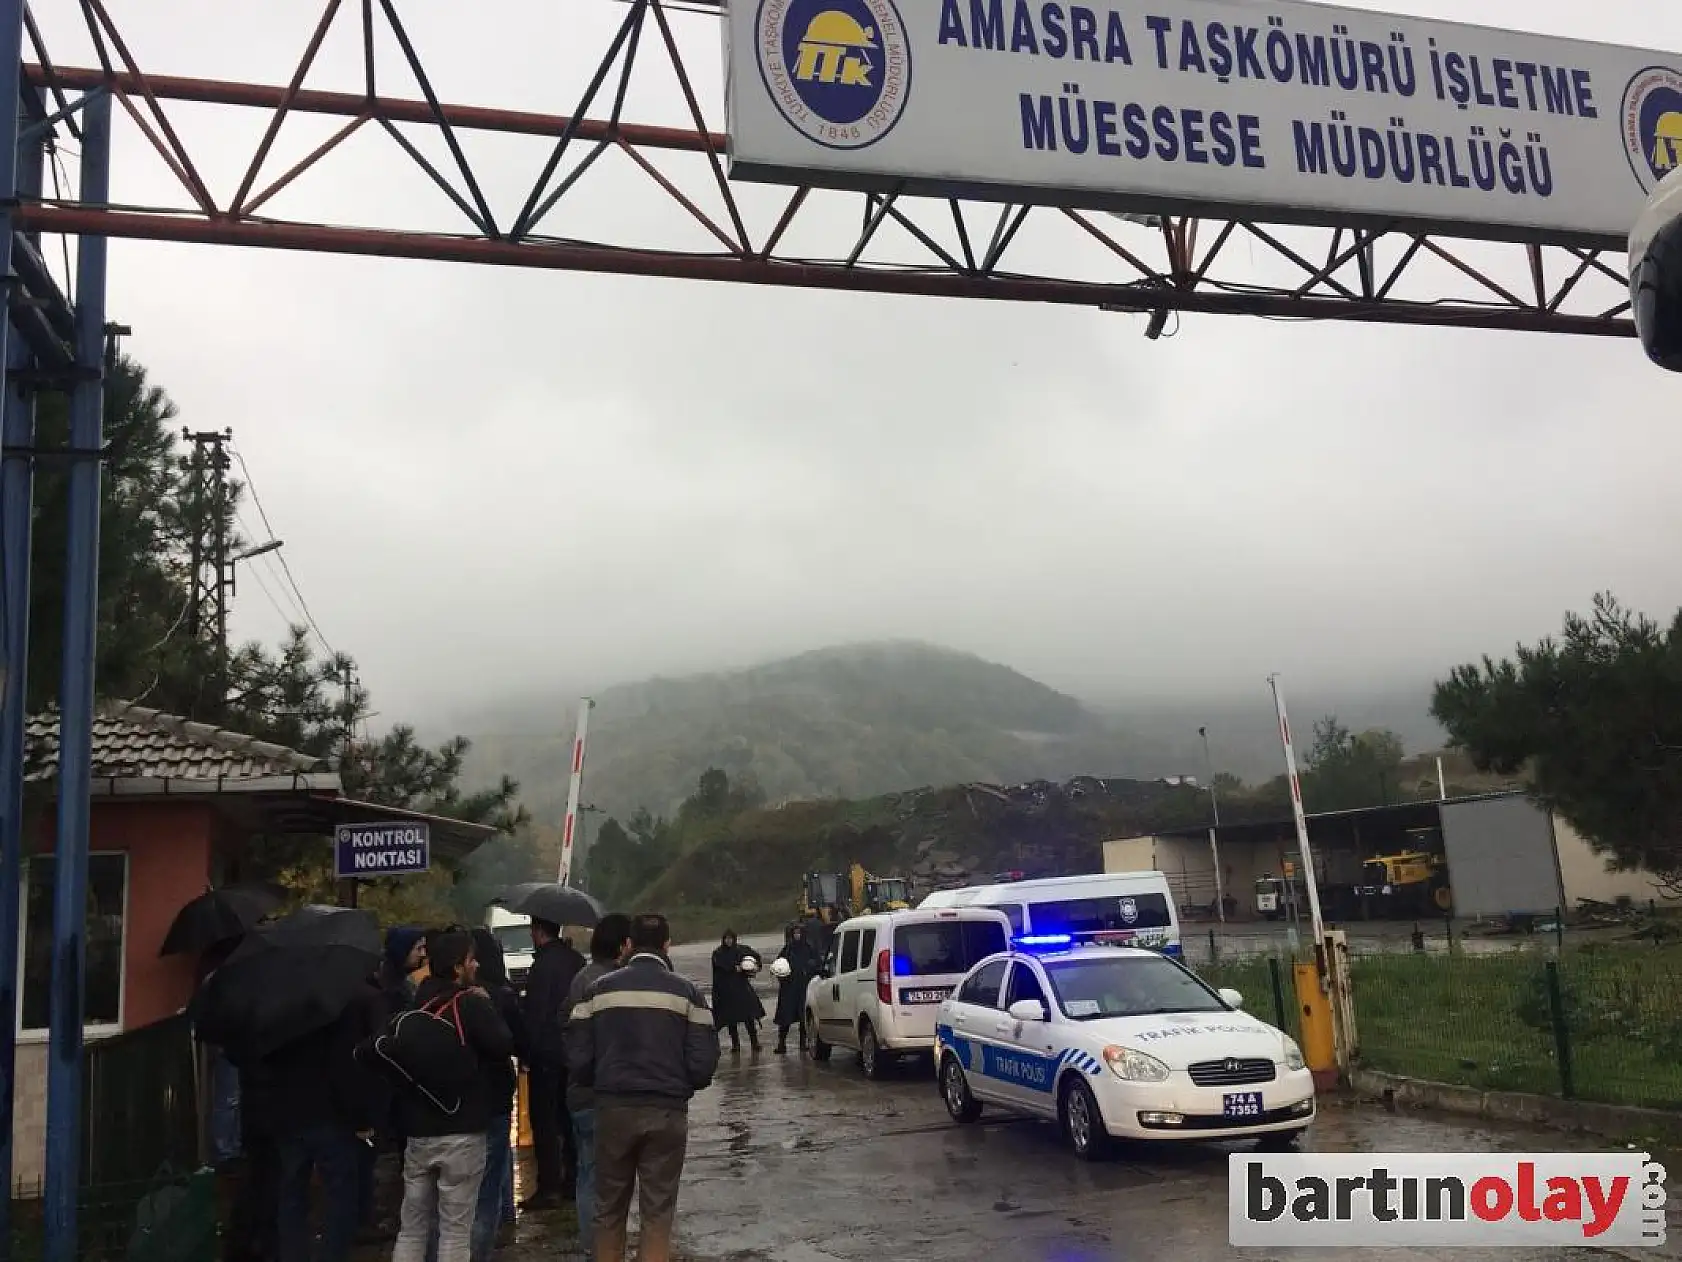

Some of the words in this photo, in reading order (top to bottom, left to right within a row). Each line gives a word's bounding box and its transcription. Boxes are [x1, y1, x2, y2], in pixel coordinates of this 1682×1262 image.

[938, 0, 1132, 66] AMASRA
[1146, 15, 1417, 97] TAŞKÖMÜRÜ
[1428, 37, 1598, 119] İŞLETME
[1018, 83, 1266, 169] MÜESSESE
[1292, 110, 1553, 197] MÜDÜRLÜĞÜ
[351, 827, 424, 848] KONTROL
[354, 848, 421, 869] NOKTASI
